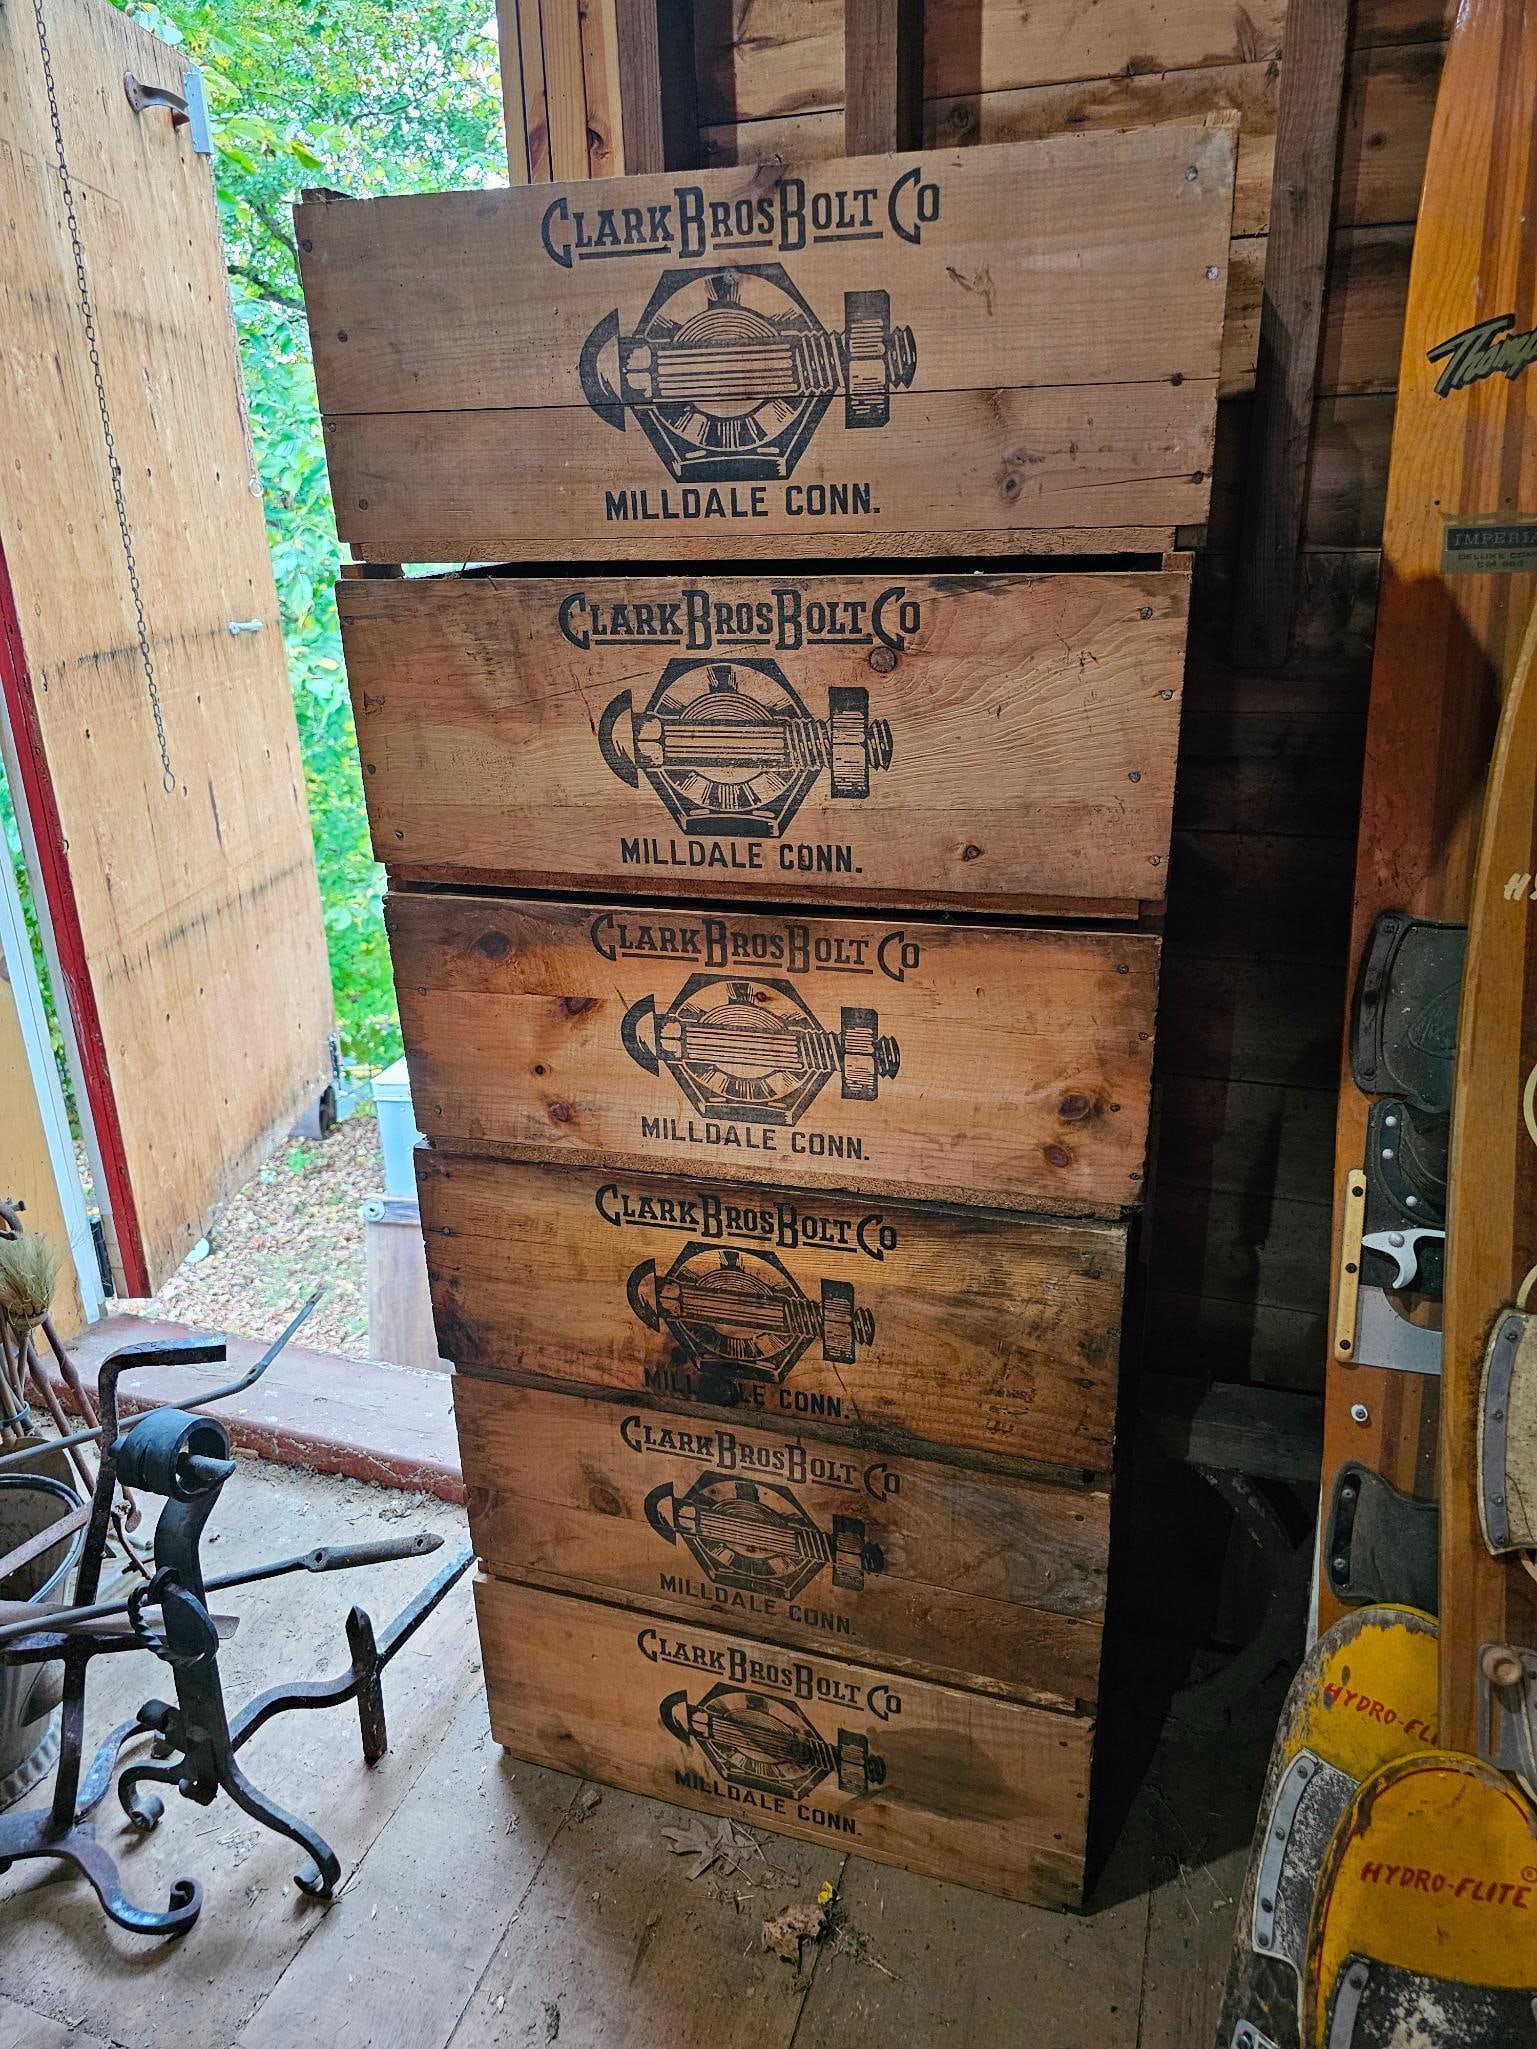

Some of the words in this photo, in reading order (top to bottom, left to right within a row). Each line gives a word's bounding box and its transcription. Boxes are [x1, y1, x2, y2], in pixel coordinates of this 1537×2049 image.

[541, 197, 674, 268] CLARK
[674, 186, 775, 259] BROS
[775, 178, 880, 251] BOLT
[888, 167, 940, 244] CO
[605, 487, 769, 521] MILLDALE
[785, 483, 881, 516] CONN.
[558, 592, 683, 650] CLARK
[682, 589, 773, 650] BROS
[771, 589, 870, 650] BOLT
[871, 587, 921, 651] CO
[620, 838, 763, 868] MILLDALE
[779, 843, 863, 873] CONN.
[590, 914, 700, 963] CLARK
[702, 919, 785, 968] BROS
[785, 924, 871, 973] BOLT
[877, 931, 921, 983] CO
[641, 1116, 777, 1151] MILLDALE
[792, 1132, 870, 1160] CONN.
[595, 1183, 699, 1231] CLARK
[699, 1193, 774, 1239] BROS
[774, 1202, 854, 1251] BOLT
[856, 1214, 898, 1262] CO
[779, 1389, 850, 1419] CONN.
[620, 1415, 714, 1461] CLARK
[715, 1430, 785, 1473] BROS
[785, 1443, 858, 1489] BOLT
[863, 1463, 900, 1503] CO
[660, 1573, 776, 1614] MILLDALE
[788, 1604, 856, 1636] CONN.
[637, 1628, 726, 1674] CLARK
[727, 1646, 793, 1687] BROS
[793, 1662, 862, 1706] BOLT
[866, 1684, 901, 1722] CO
[673, 1769, 786, 1815] MILLDALE
[797, 1805, 862, 1836] CONN.
[1360, 1861, 1532, 1909] HYDRO-FLITE
